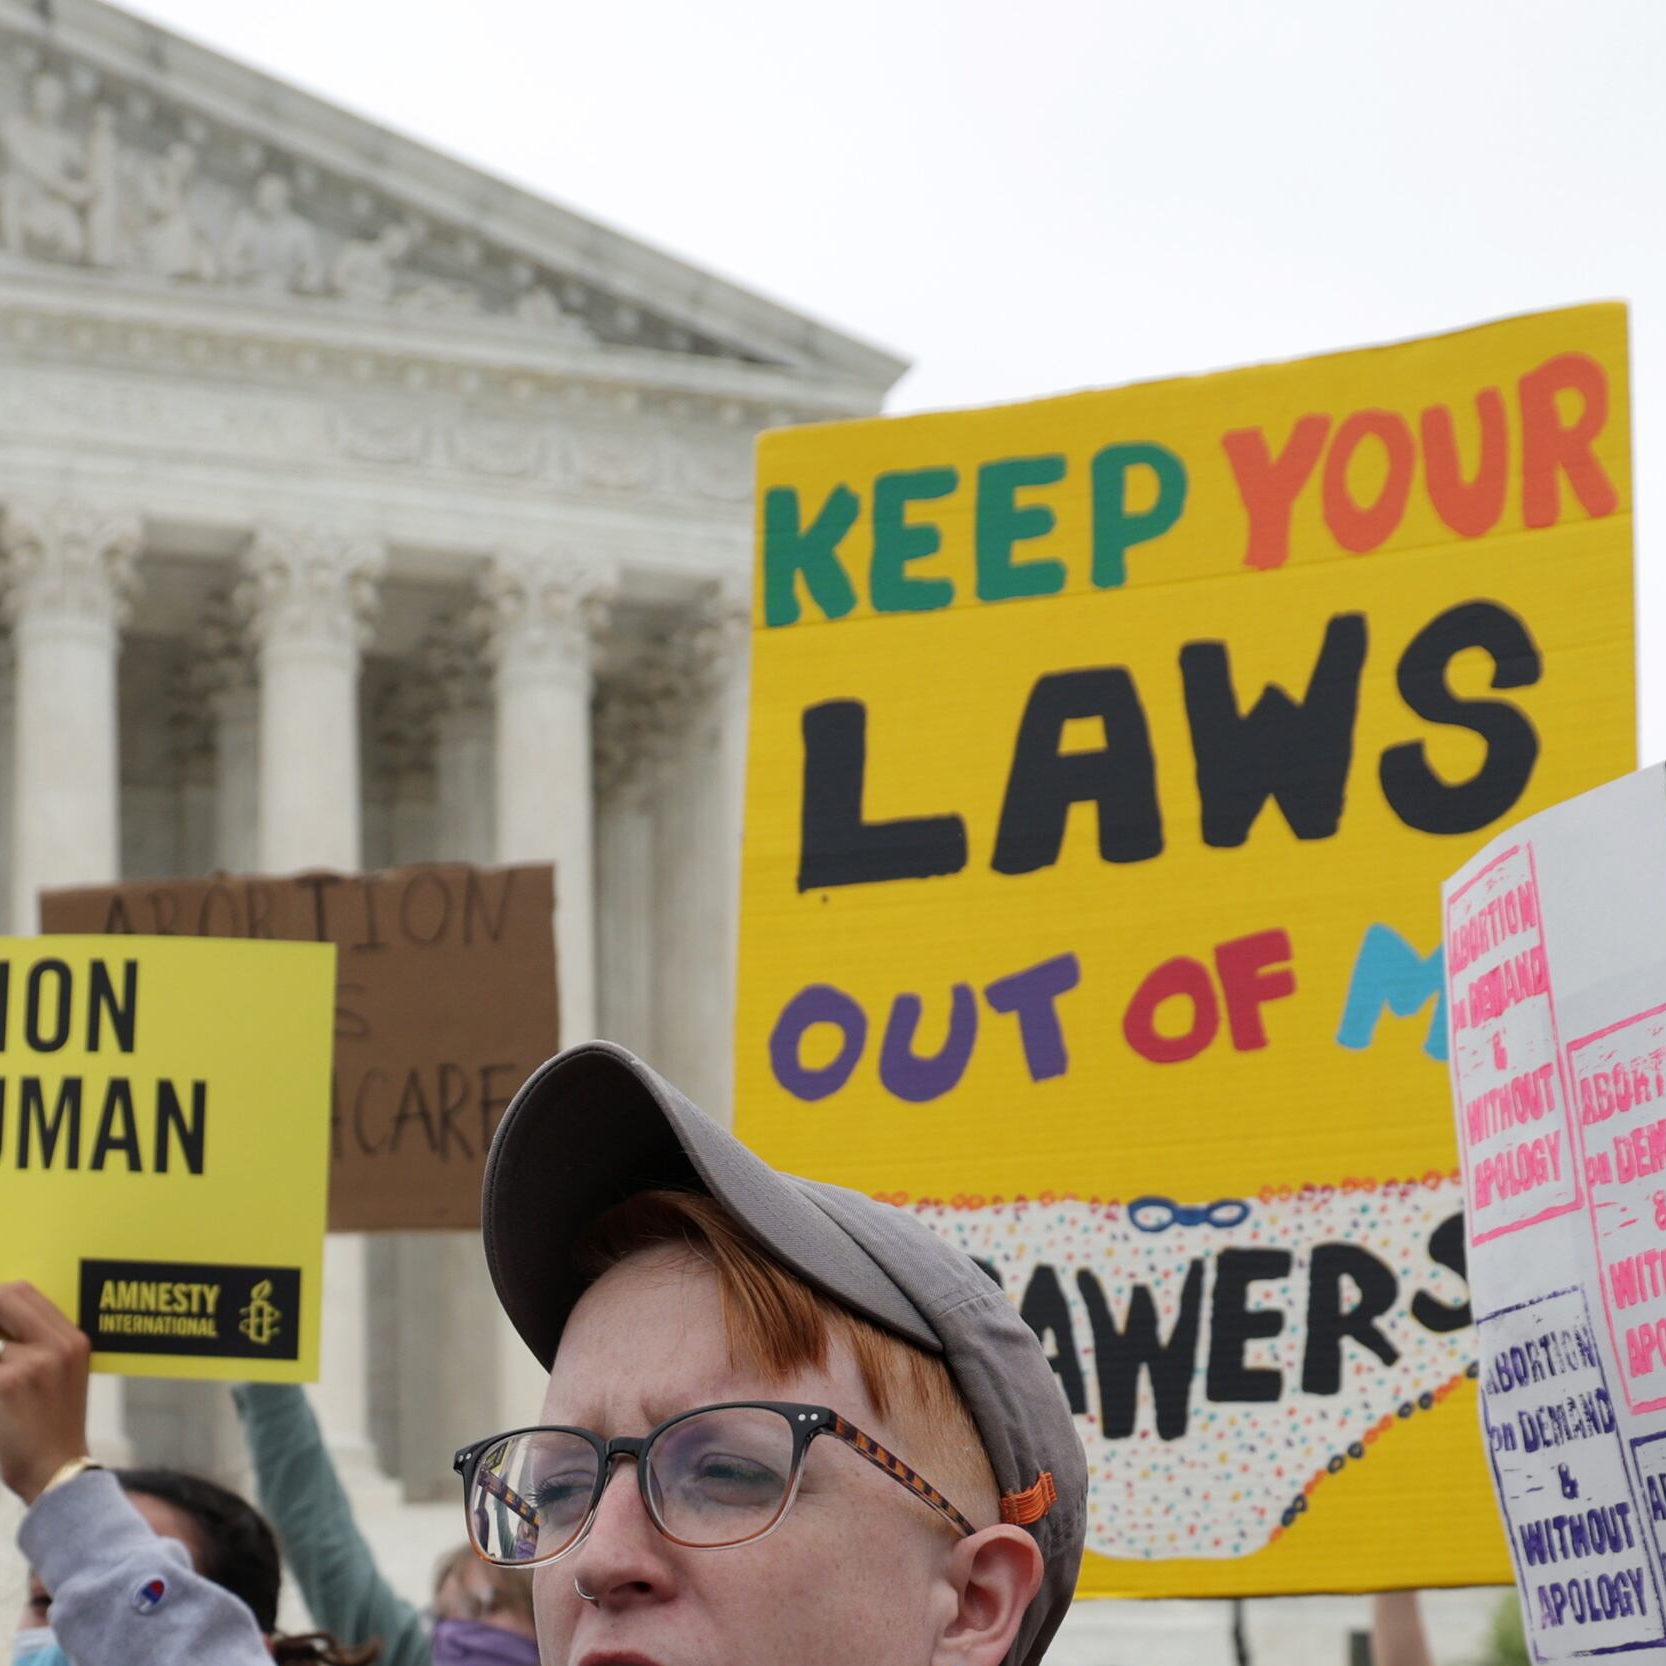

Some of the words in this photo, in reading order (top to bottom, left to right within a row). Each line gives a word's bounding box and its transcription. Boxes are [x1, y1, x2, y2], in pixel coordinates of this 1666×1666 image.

[763, 441, 1188, 628] KEEP
[1221, 351, 1620, 571] YOUR
[796, 597, 1543, 895] LAWS
[768, 950, 1082, 1103] OUT
[1122, 927, 1297, 1065] OF
[1335, 922, 1450, 1063] M
[1467, 1063, 1555, 1145] WITHOUT
[1474, 1131, 1561, 1210] APOLOGY
[98, 1279, 221, 1316] AMNESTY
[98, 1314, 219, 1339] INTERNATIONAL
[973, 1216, 1476, 1440] AWERS
[1519, 1501, 1636, 1567] WITHOUT
[1536, 1568, 1645, 1629] APOLOGY
